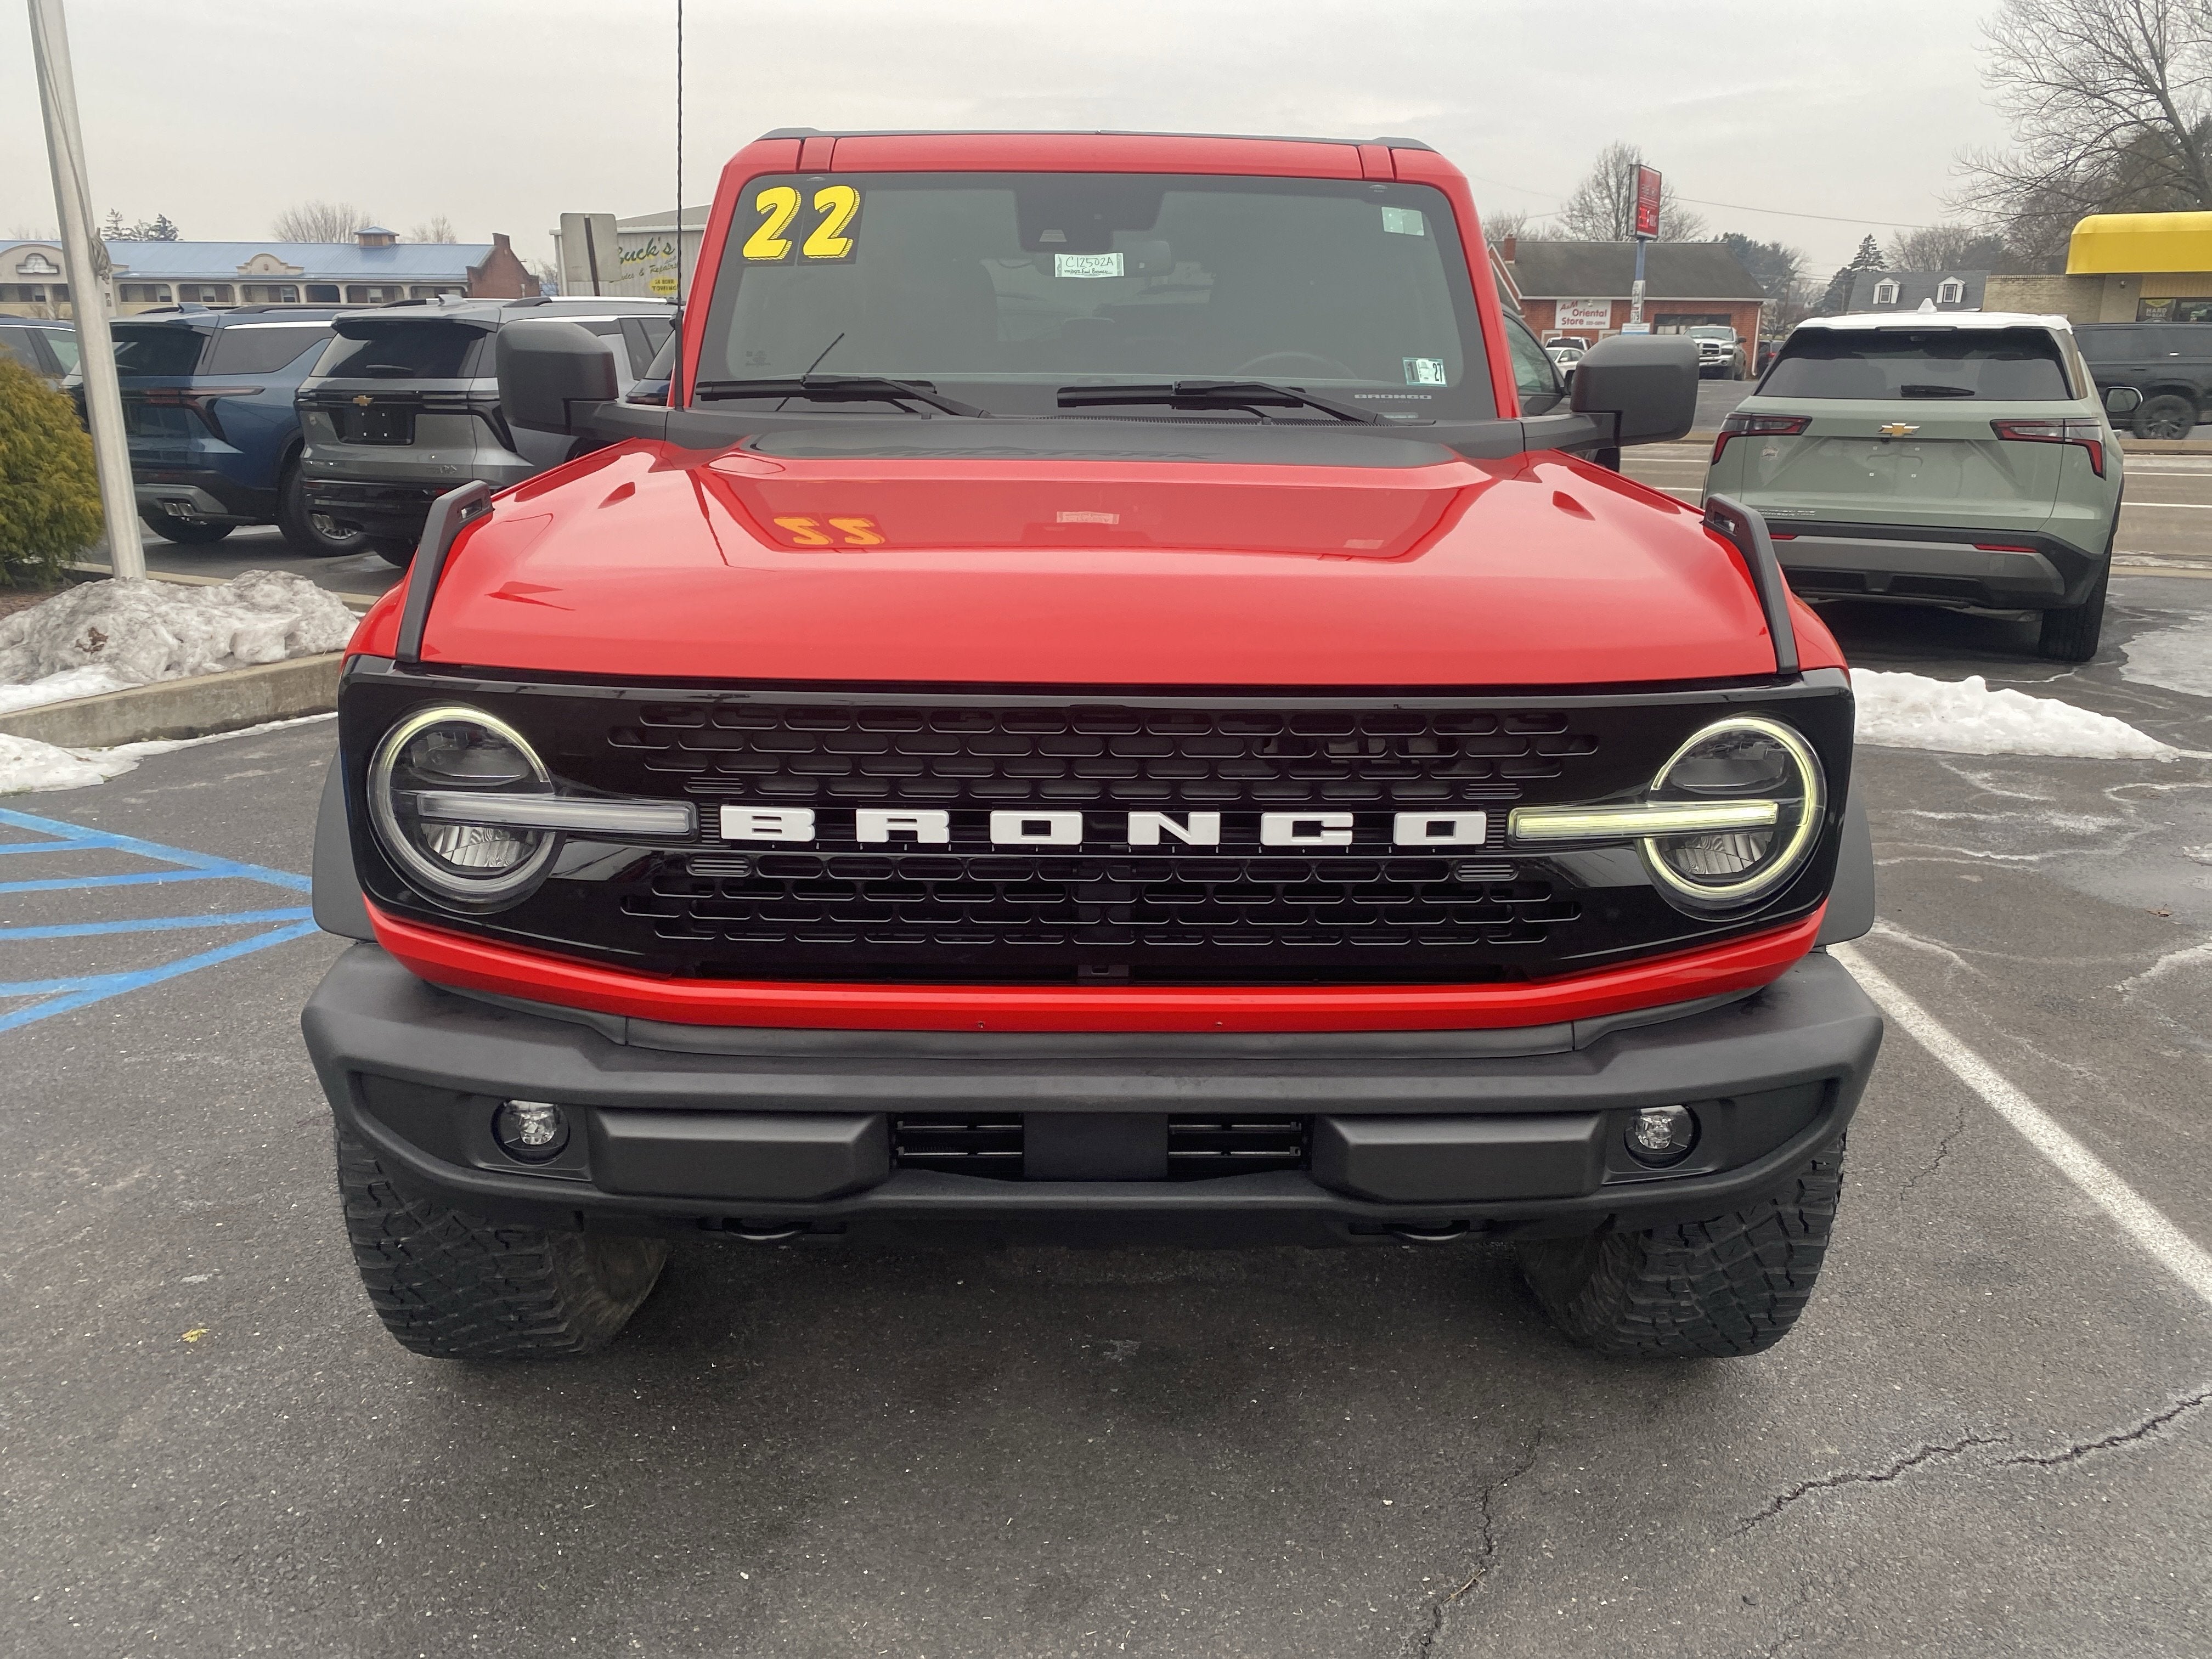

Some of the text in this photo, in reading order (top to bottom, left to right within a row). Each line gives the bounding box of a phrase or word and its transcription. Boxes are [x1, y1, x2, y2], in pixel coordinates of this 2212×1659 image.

[742, 185, 860, 260] 22
[1065, 256, 1113, 268] C12502A
[639, 268, 645, 276] &
[1572, 309, 1607, 317] Oriental
[1432, 363, 1442, 383] 27
[720, 805, 1487, 846] BRONCO
